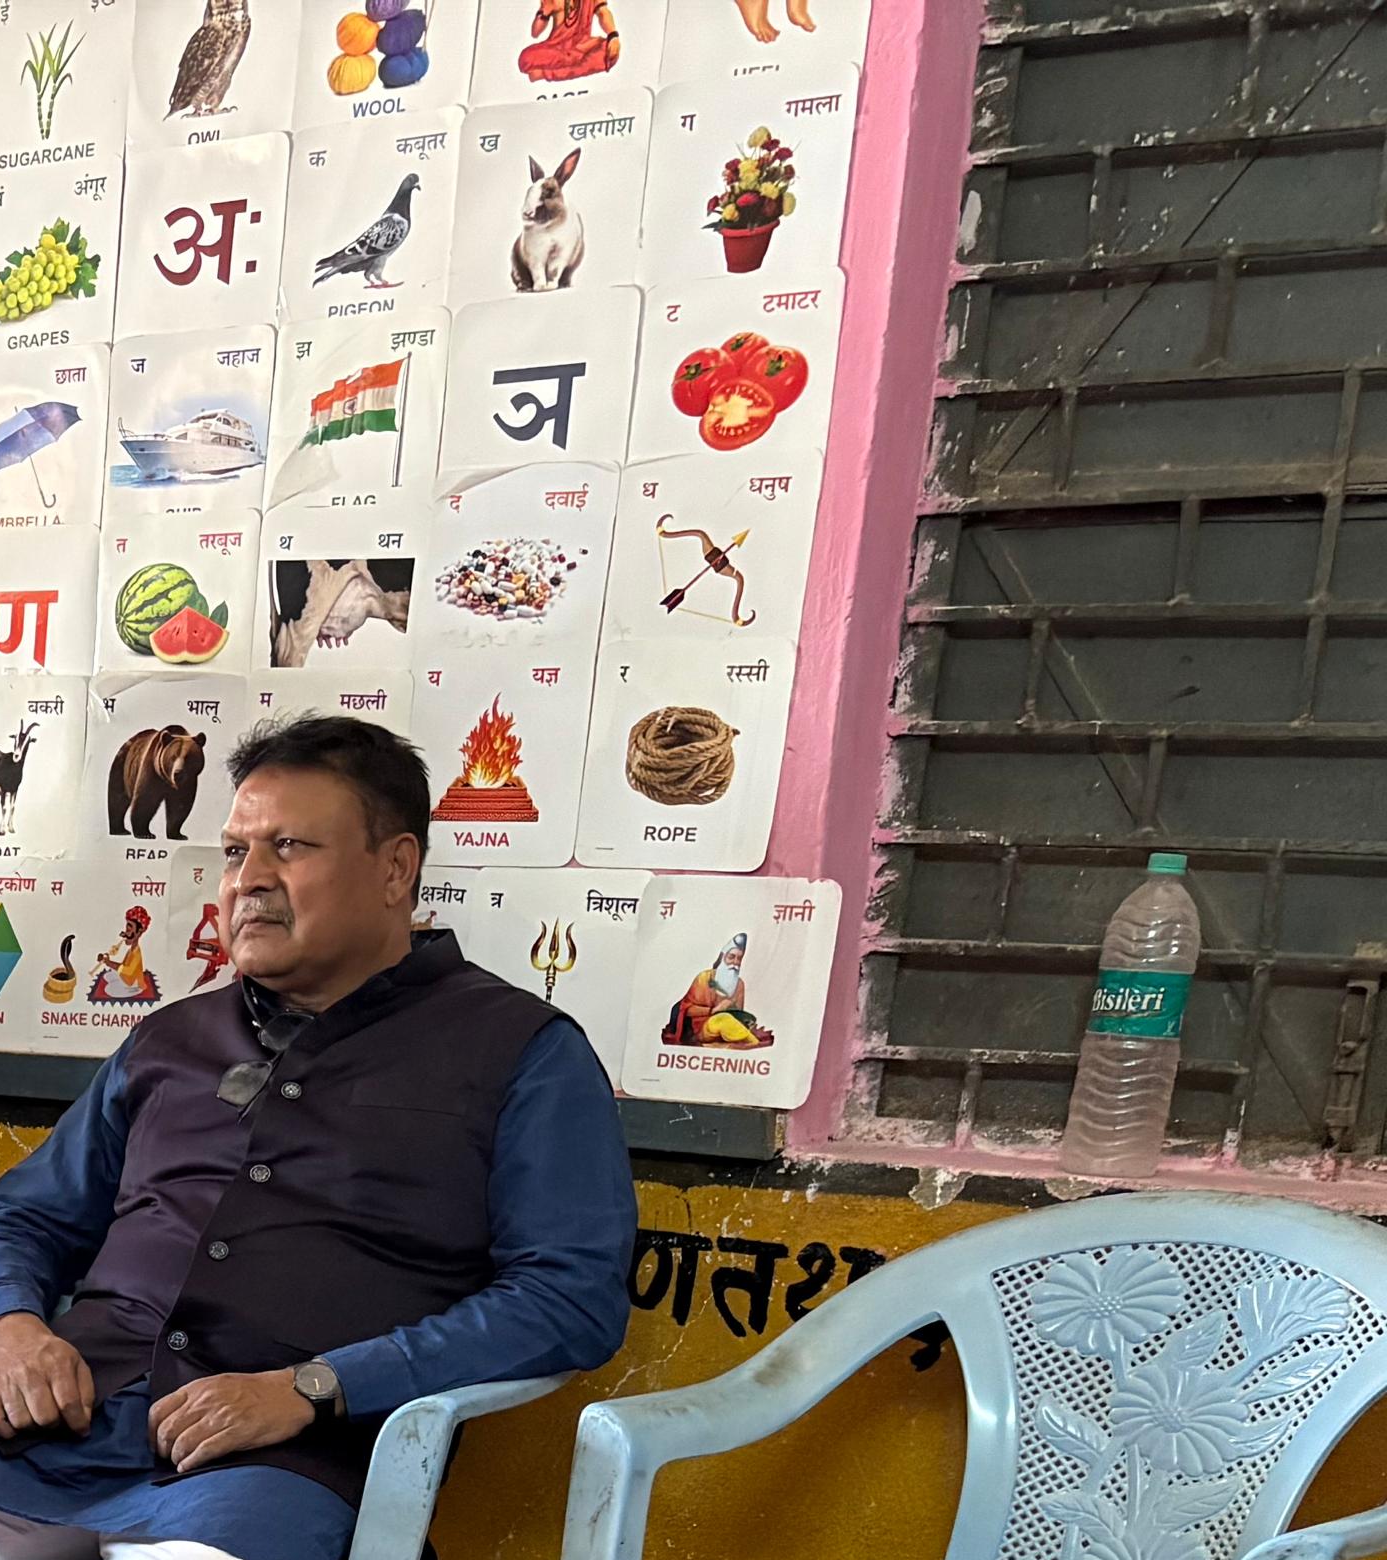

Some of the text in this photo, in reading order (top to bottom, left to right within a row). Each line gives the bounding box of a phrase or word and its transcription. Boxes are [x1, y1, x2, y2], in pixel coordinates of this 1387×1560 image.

[352, 97, 406, 119] WOOL
[680, 93, 842, 132] ग गमला
[479, 115, 634, 154] ख खरगोश
[309, 132, 447, 168] क कबूतर
[74, 172, 106, 201] अंगूर
[154, 199, 261, 286] अः
[667, 290, 821, 323] ट टमाटर
[8, 330, 70, 350] GRAPES
[296, 329, 435, 358] झ झण्डा
[132, 349, 261, 373] ज जहाज
[56, 367, 86, 384] छाता
[450, 484, 589, 512] द दवाई
[643, 476, 791, 500] ध धनुष
[117, 532, 243, 556] त तरबूज
[379, 533, 402, 548] थन
[428, 667, 560, 686] य यज्ञ
[620, 659, 769, 683] र रस्सी
[28, 695, 64, 714] बकरी
[188, 700, 221, 723] भालू
[260, 689, 387, 710] म मछली
[454, 831, 510, 847] YAJNA
[643, 826, 697, 842] ROPE
[51, 876, 166, 897] स सपेरा
[587, 890, 639, 921] त्रिशूल
[660, 900, 815, 924] ज्ञ ज्ञानी
[42, 1012, 87, 1025] SNAKE
[657, 1053, 770, 1076] DISCERNING
[711, 1236, 789, 1337] त
